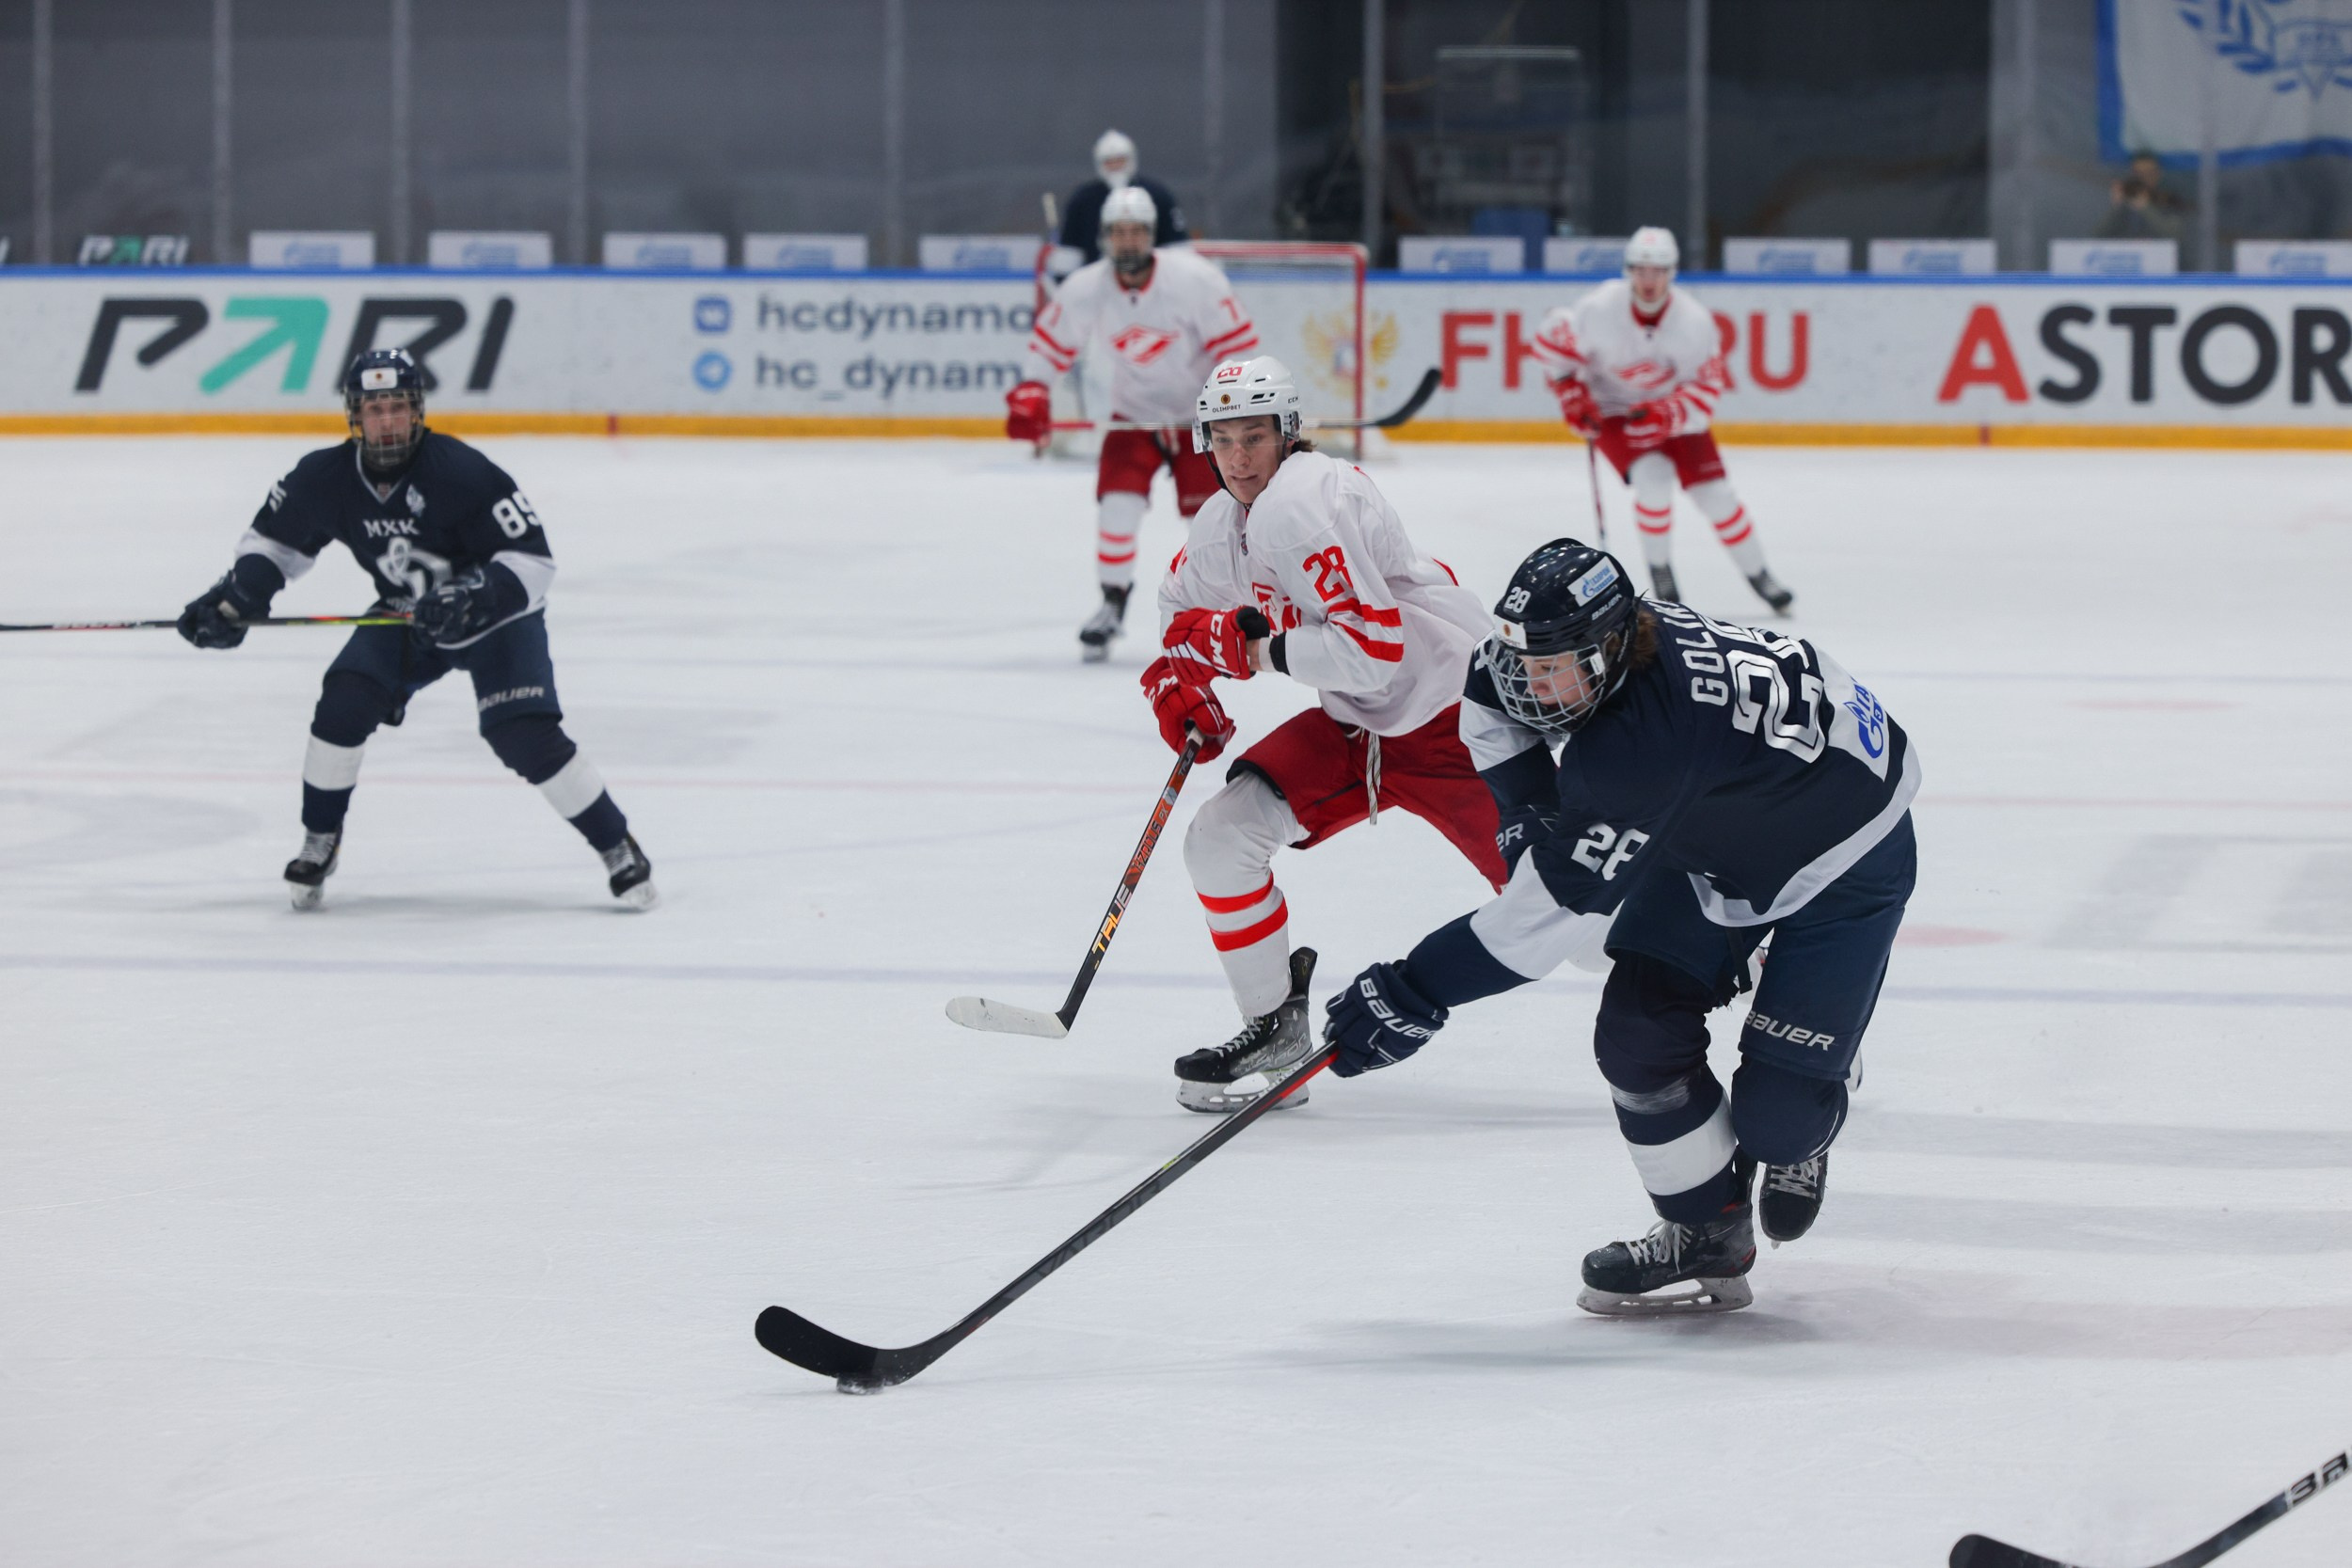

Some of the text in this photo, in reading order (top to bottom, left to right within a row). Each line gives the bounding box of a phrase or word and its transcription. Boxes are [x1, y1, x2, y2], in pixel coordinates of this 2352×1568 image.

[78, 236, 187, 266] PARI
[74, 295, 515, 394] PARI
[1212, 404, 1241, 413] OLIMPBET
[1302, 545, 1354, 603] 28
[1503, 586, 1532, 613] 28
[1158, 804, 1168, 822] PX
[1570, 822, 1650, 881] 28
[1091, 883, 1134, 954] TRUE
[1359, 977, 1437, 1039] BAUER
